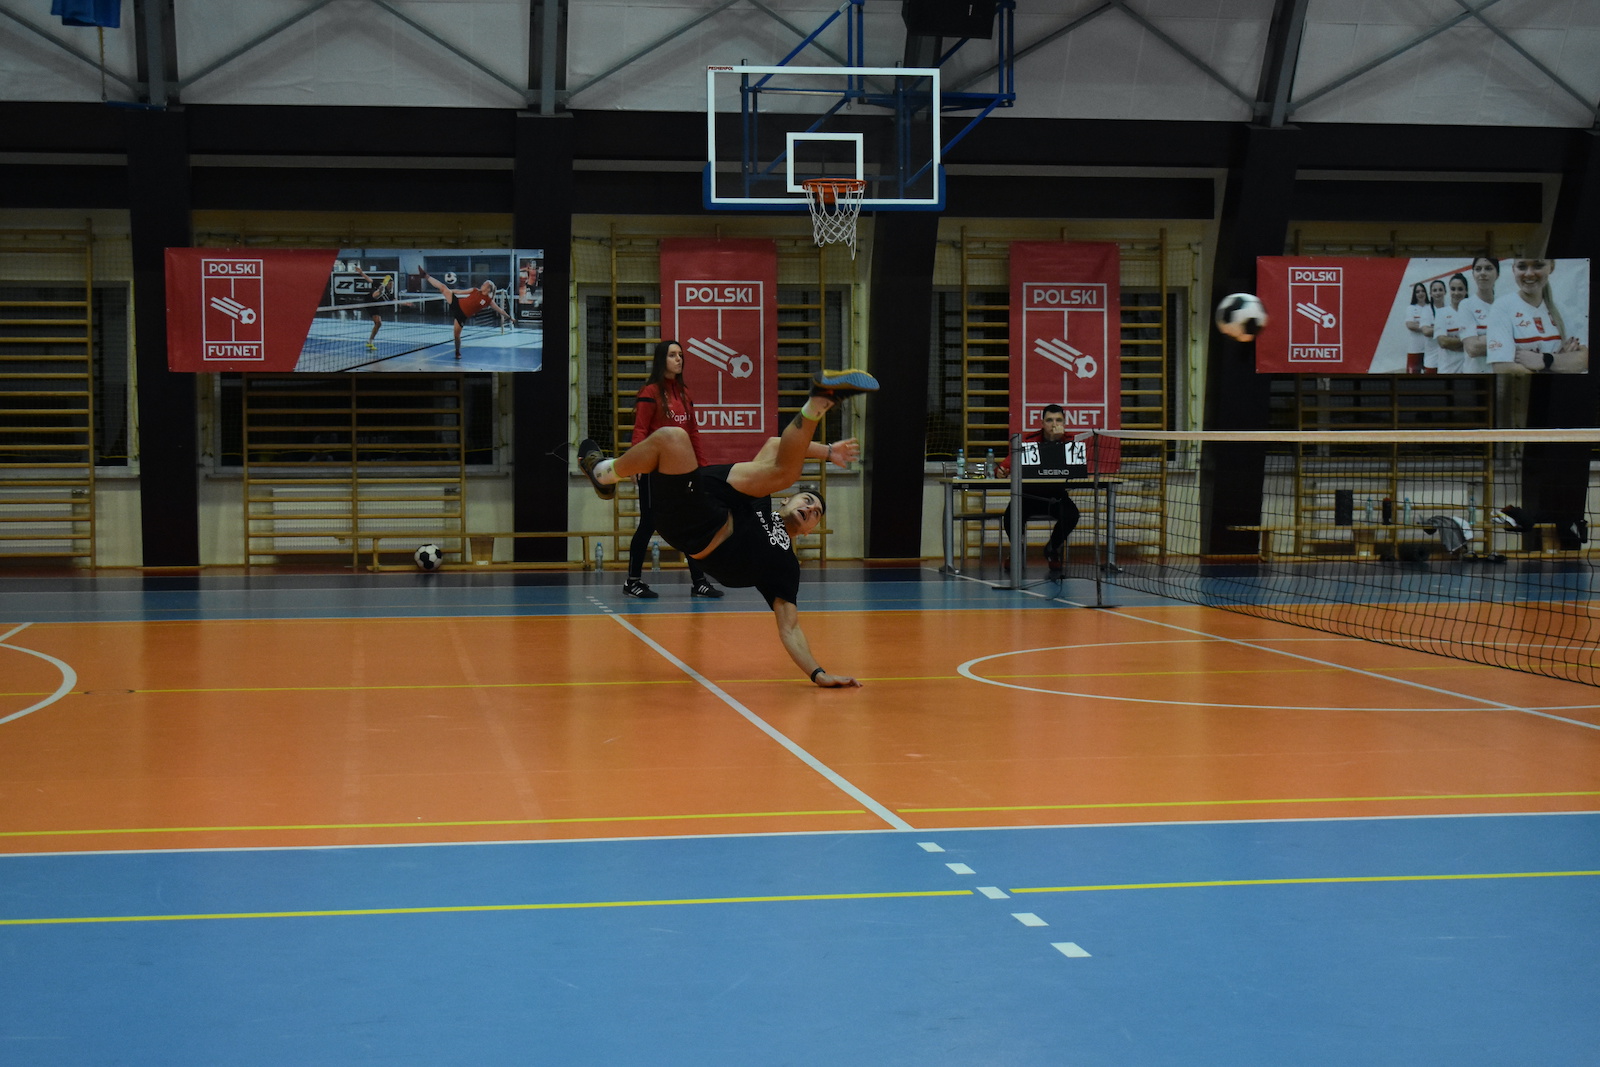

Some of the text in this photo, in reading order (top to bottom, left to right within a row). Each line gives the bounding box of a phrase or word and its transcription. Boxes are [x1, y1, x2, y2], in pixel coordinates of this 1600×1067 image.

[209, 263, 256, 274] POLSKI
[1295, 271, 1337, 282] POLSKI
[686, 287, 753, 303] POLSKI
[1033, 289, 1097, 305] POLSKI
[208, 345, 259, 356] FUTNET
[1292, 347, 1338, 359] FUTNET
[695, 410, 757, 426] UTNET
[1029, 409, 1101, 426] FNET
[1067, 443, 1085, 463] 14
